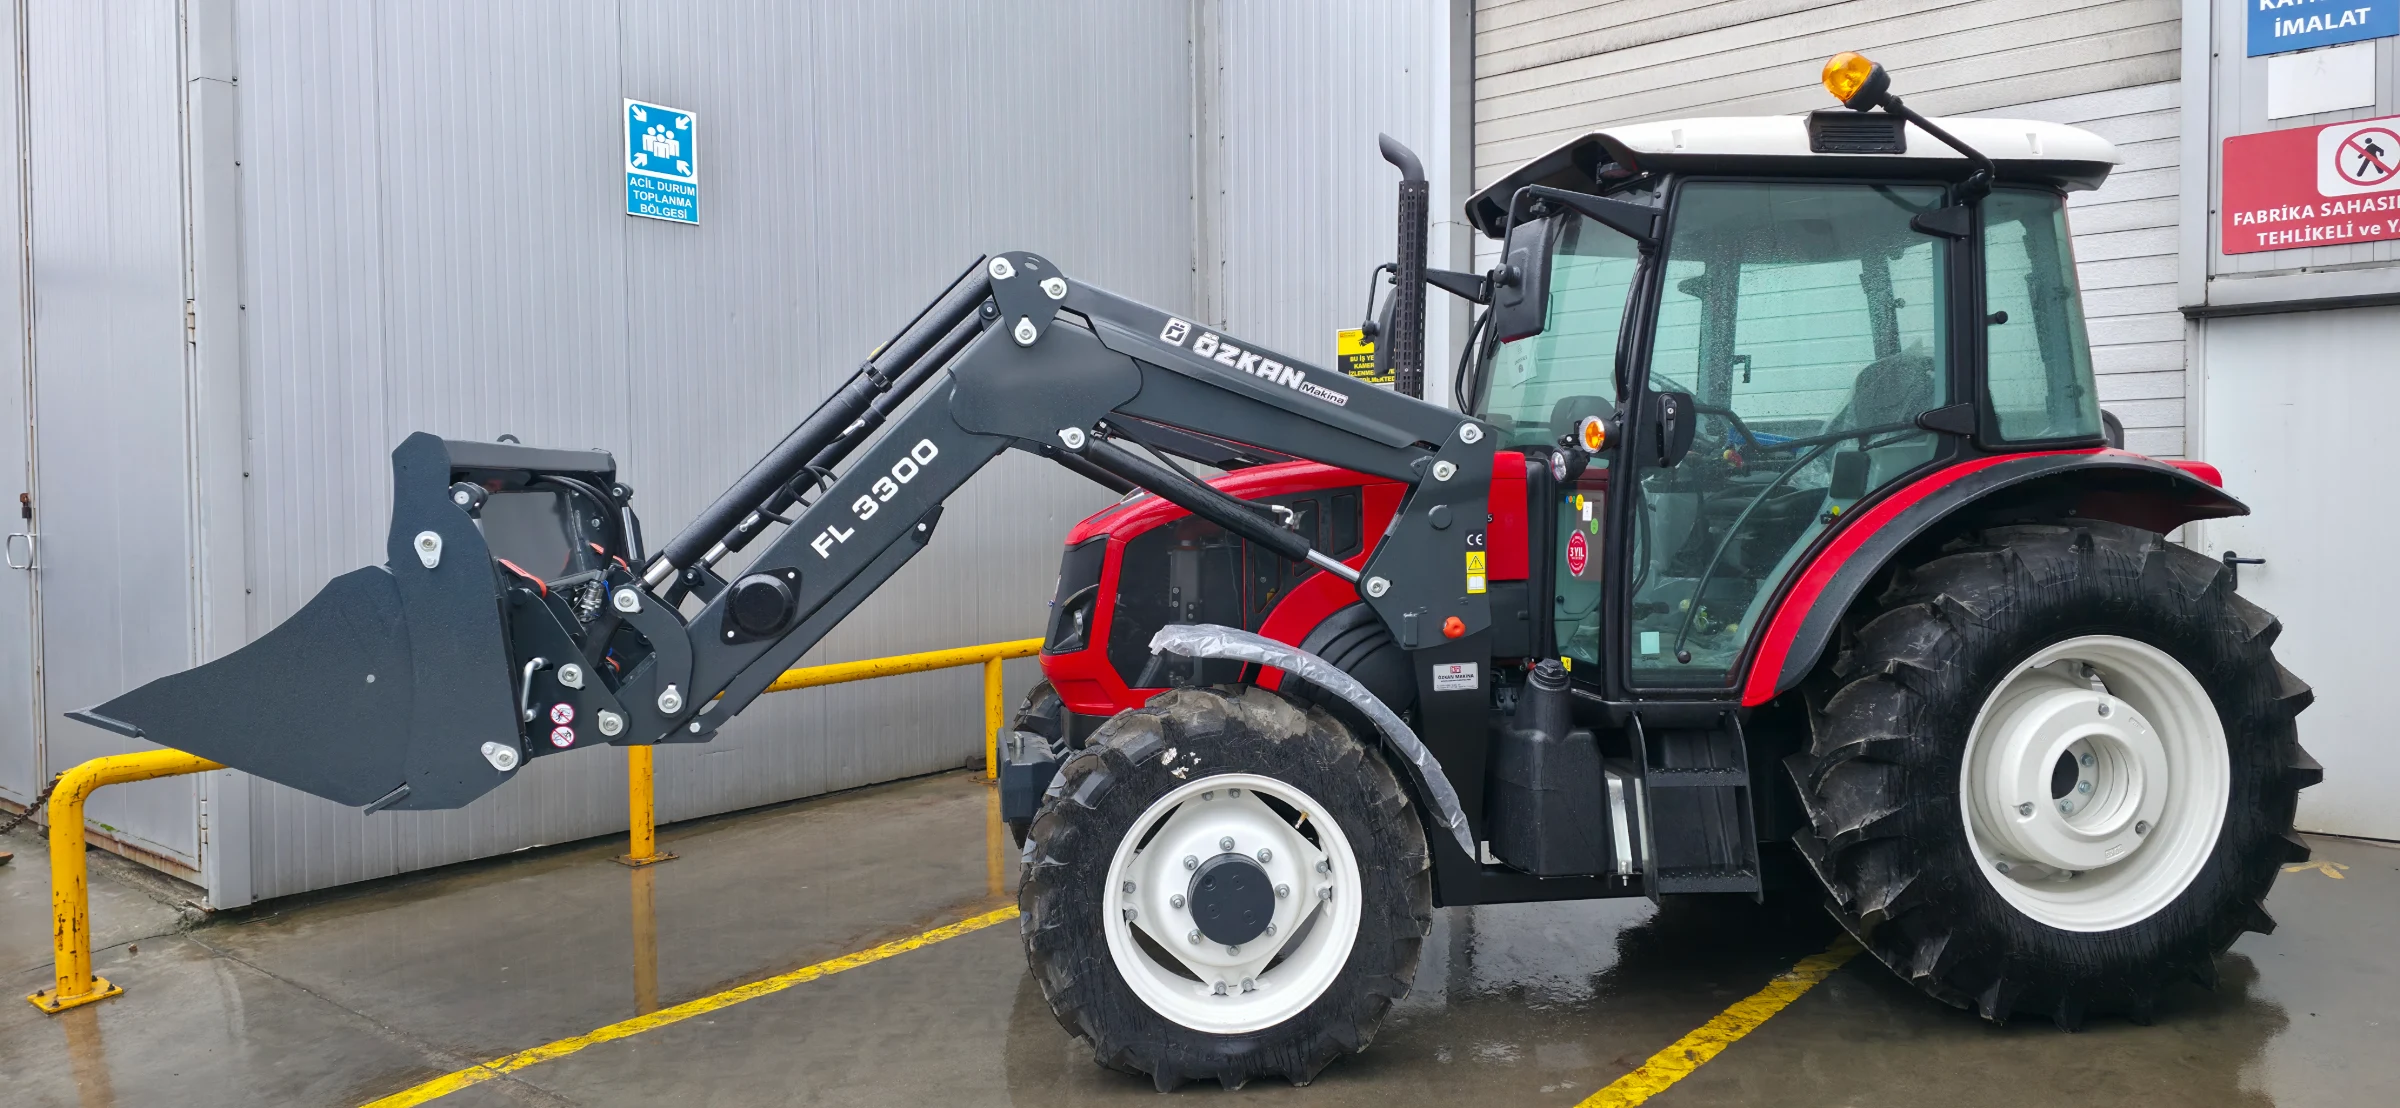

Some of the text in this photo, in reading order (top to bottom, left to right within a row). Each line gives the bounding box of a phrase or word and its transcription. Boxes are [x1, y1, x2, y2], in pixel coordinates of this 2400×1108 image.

[2275, 7, 2371, 38] İMALAT
[630, 177, 695, 197] ACİL DURUM
[633, 190, 693, 208] TOPLANMA
[640, 204, 687, 219] BÖLGESİ
[2234, 204, 2315, 226] FABRİKA
[2257, 219, 2400, 246] TEHLİKELİ ve Y
[1193, 332, 1344, 404] ÖZKAN Makina
[811, 439, 938, 559] FL 3300
[1467, 534, 1482, 546] CE
[1570, 547, 1584, 556] 3 YIL
